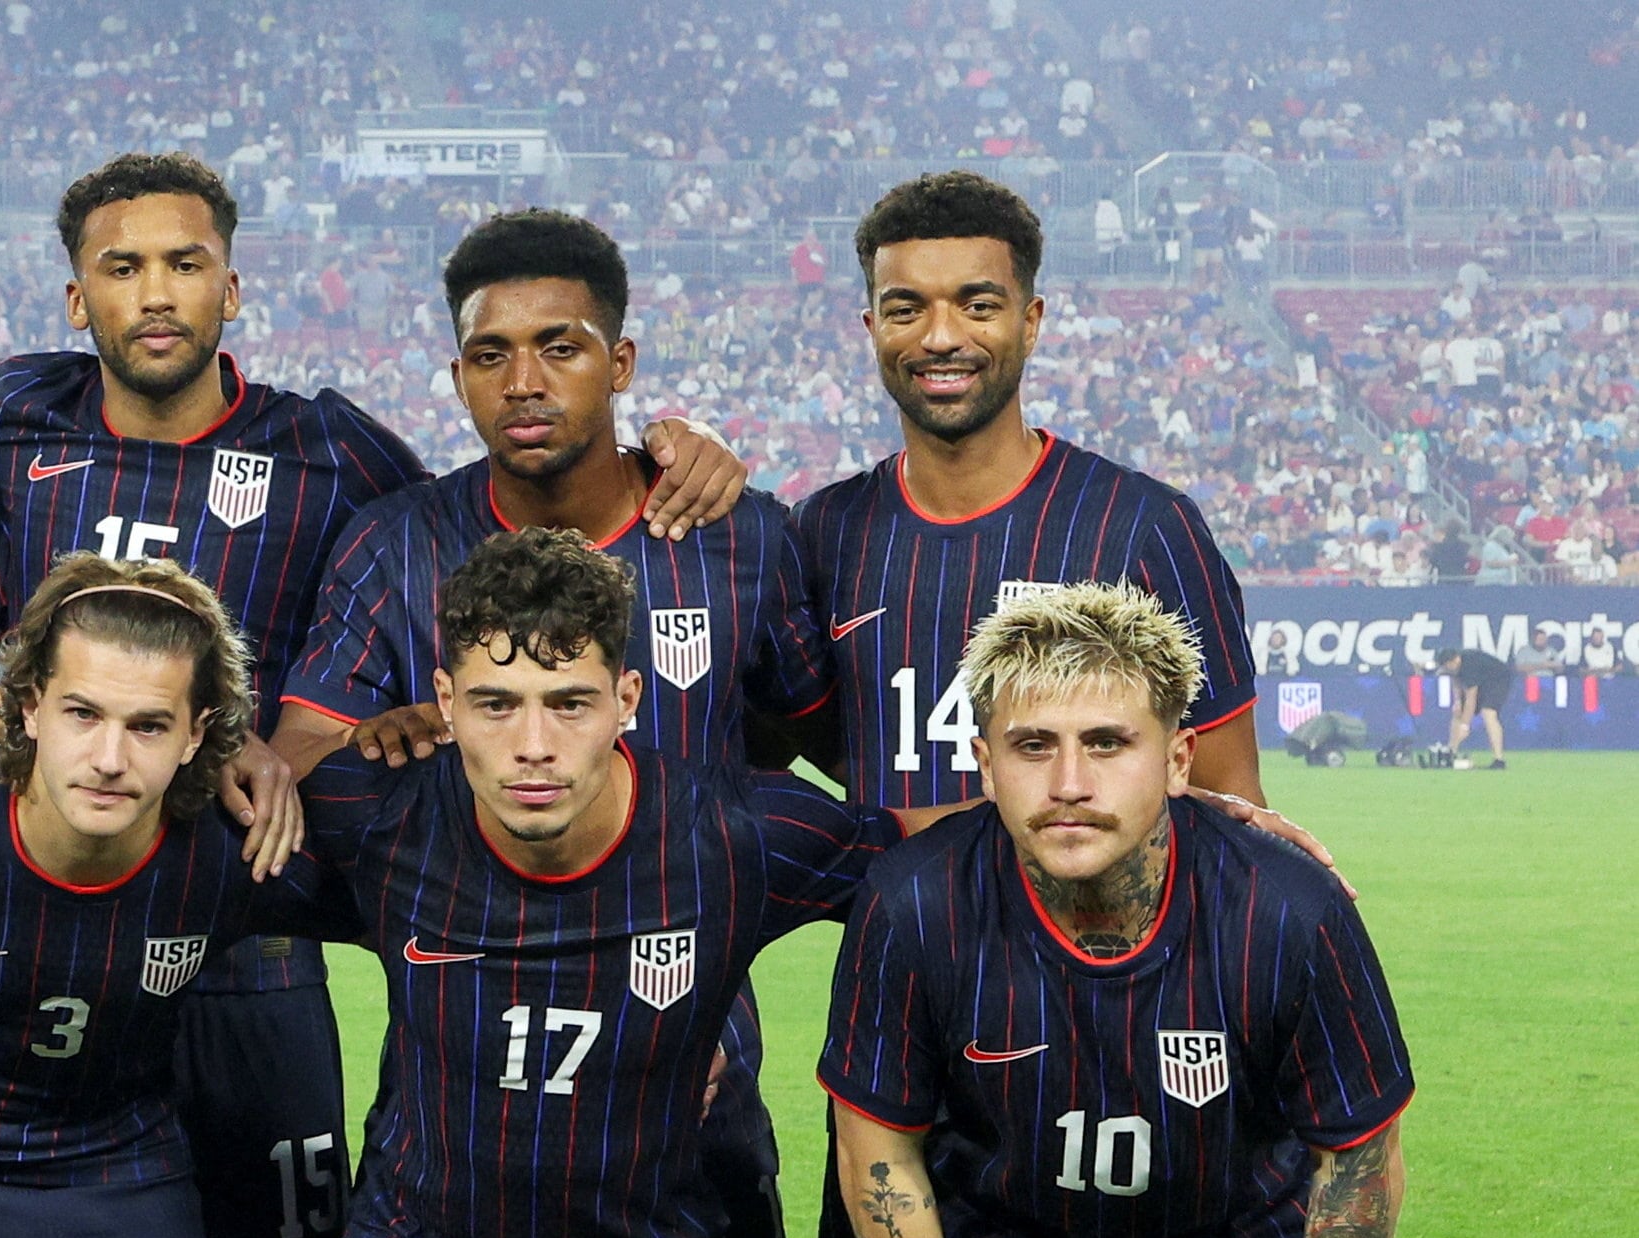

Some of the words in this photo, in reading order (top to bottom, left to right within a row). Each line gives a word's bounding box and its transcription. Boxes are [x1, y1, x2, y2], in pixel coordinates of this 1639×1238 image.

[385, 143, 521, 162] METERS
[217, 454, 269, 485] USA
[656, 613, 705, 643] USA
[1247, 612, 1443, 676] pact
[1283, 687, 1318, 707] USA
[890, 667, 979, 771] 14
[149, 940, 204, 965] USA
[635, 936, 691, 966] USA
[31, 996, 90, 1058] 3
[499, 1005, 602, 1095] 17
[1164, 1037, 1222, 1065] USA
[1056, 1110, 1151, 1197] 10
